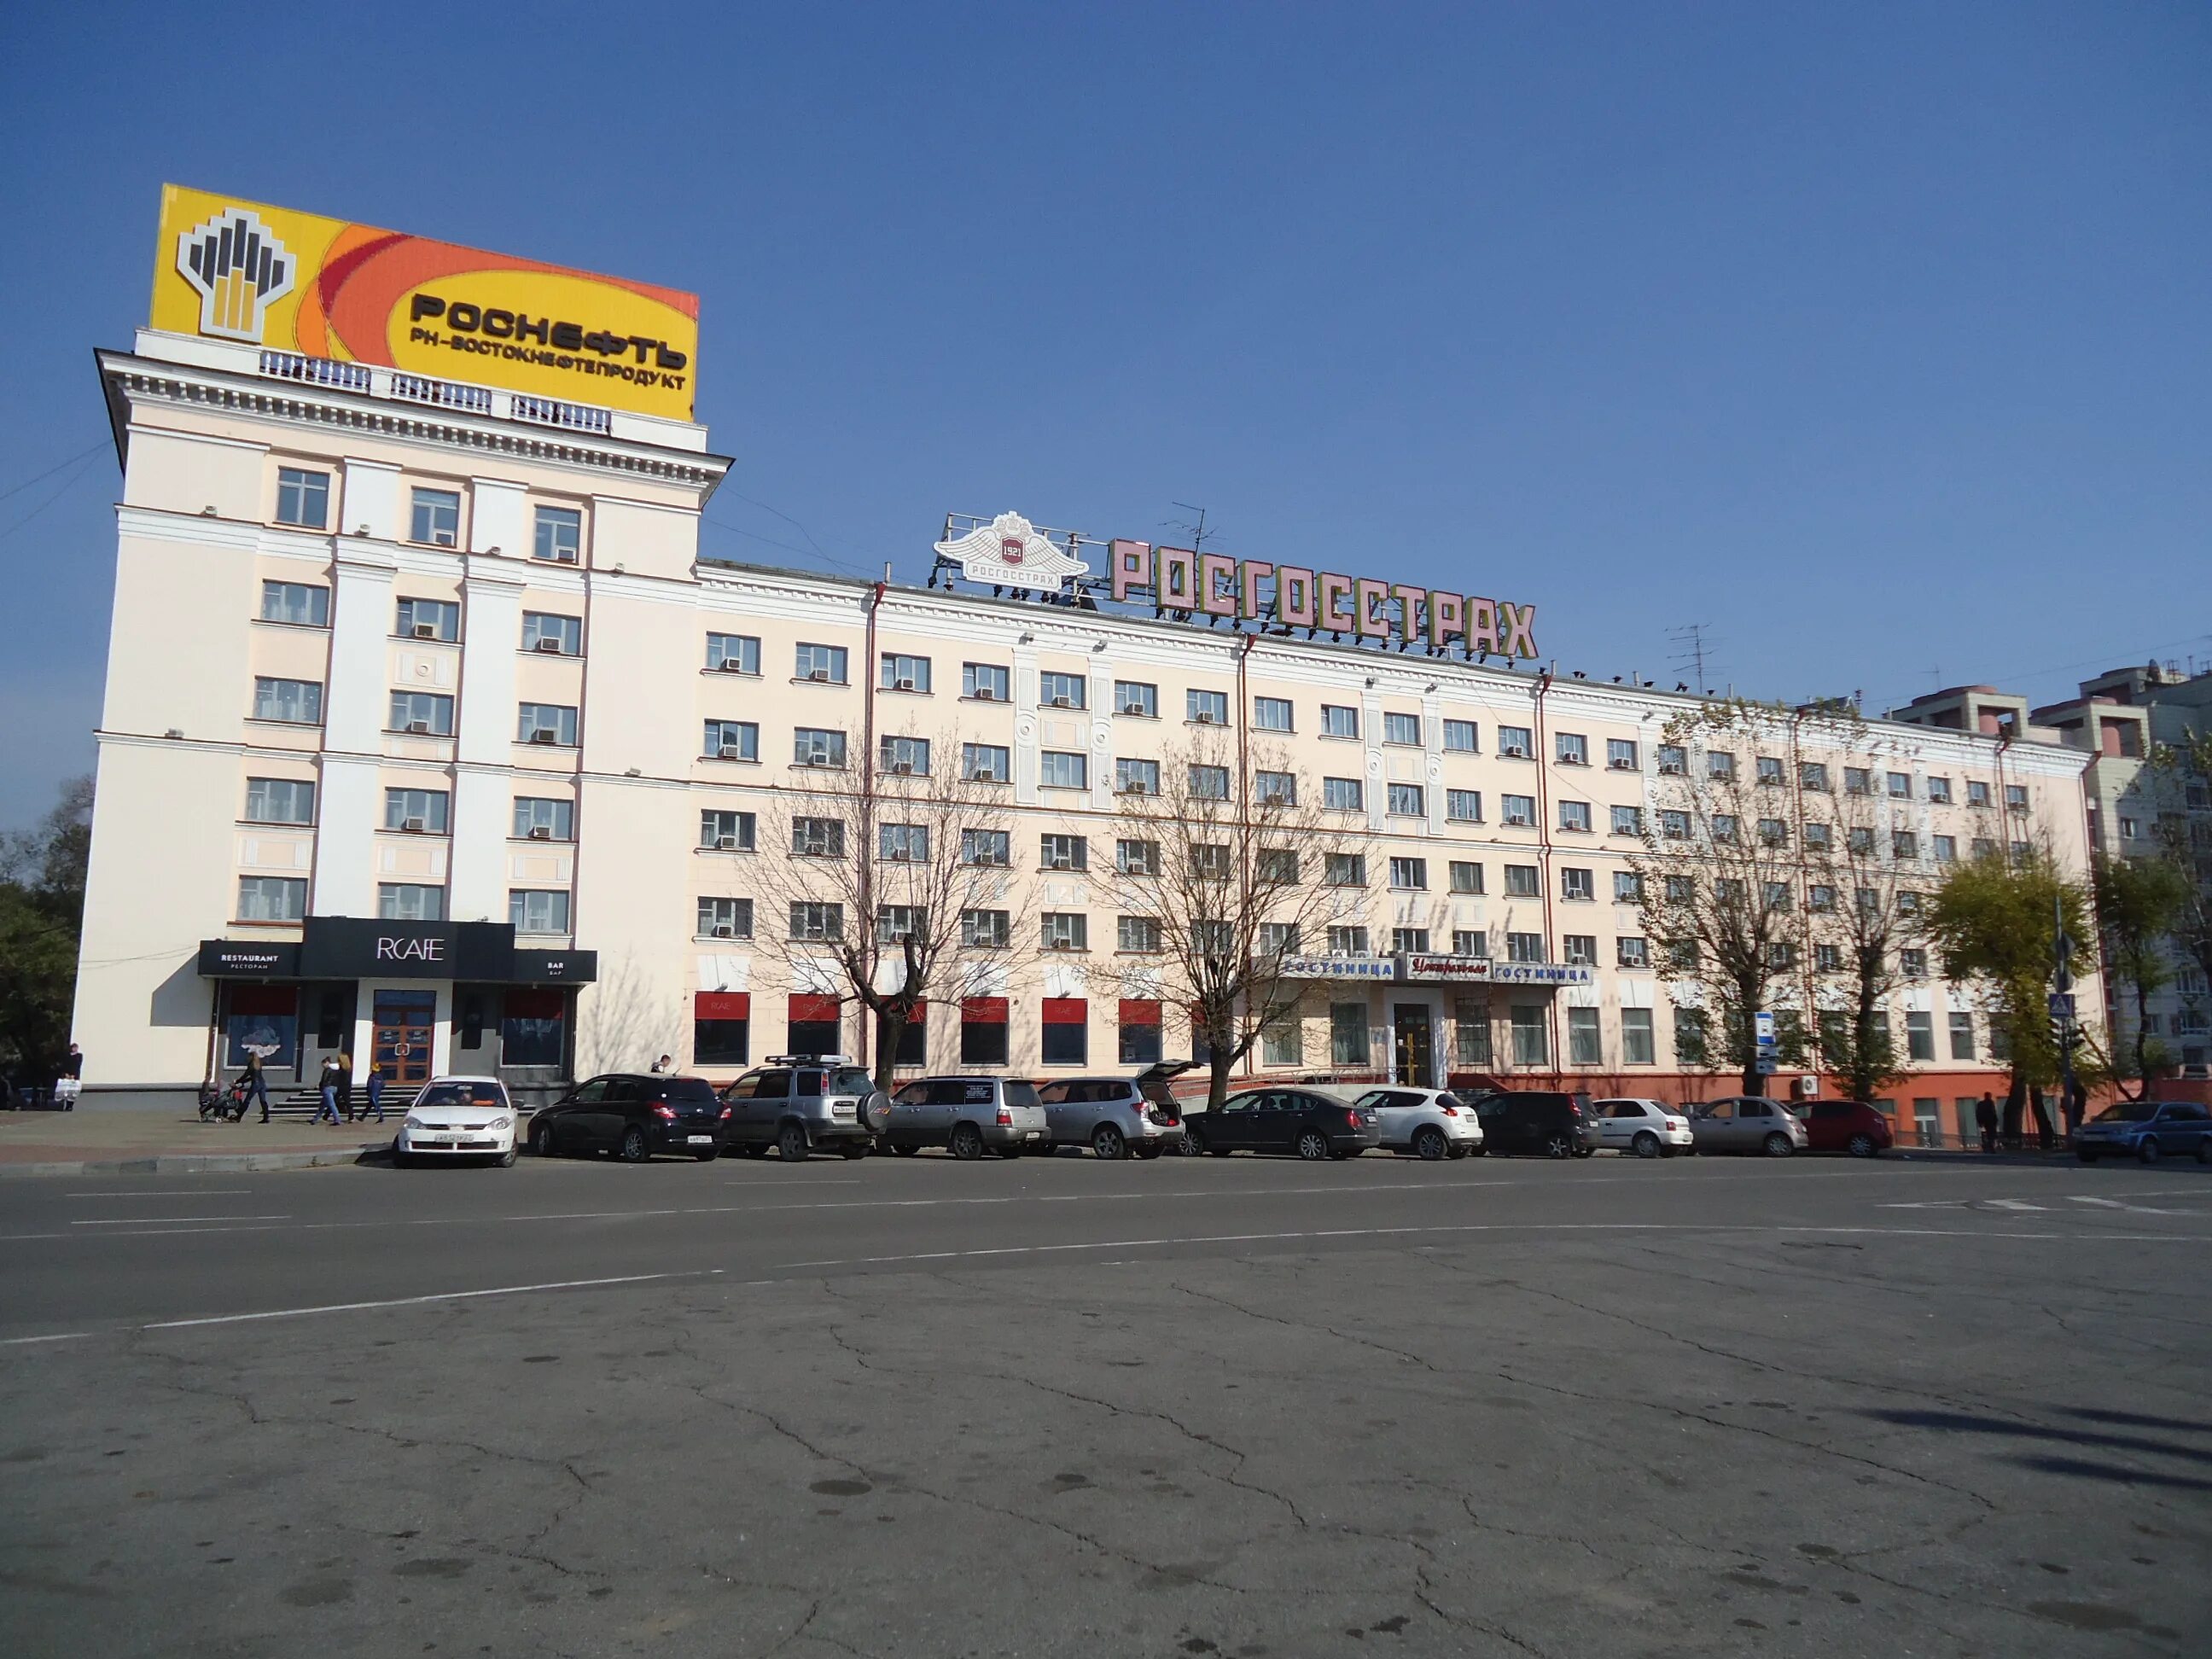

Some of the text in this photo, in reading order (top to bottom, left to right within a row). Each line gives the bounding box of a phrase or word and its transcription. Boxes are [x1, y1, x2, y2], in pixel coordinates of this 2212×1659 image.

[410, 294, 686, 370] РОСНЕФТЬ
[410, 327, 685, 390] РН-ВОСТОКНЕФТЕПРОДУКТ
[973, 565, 1053, 585] РОСГОССТРАХ
[1004, 546, 1022, 557] 1921
[1110, 538, 1539, 659] РОСГОССТРАХ
